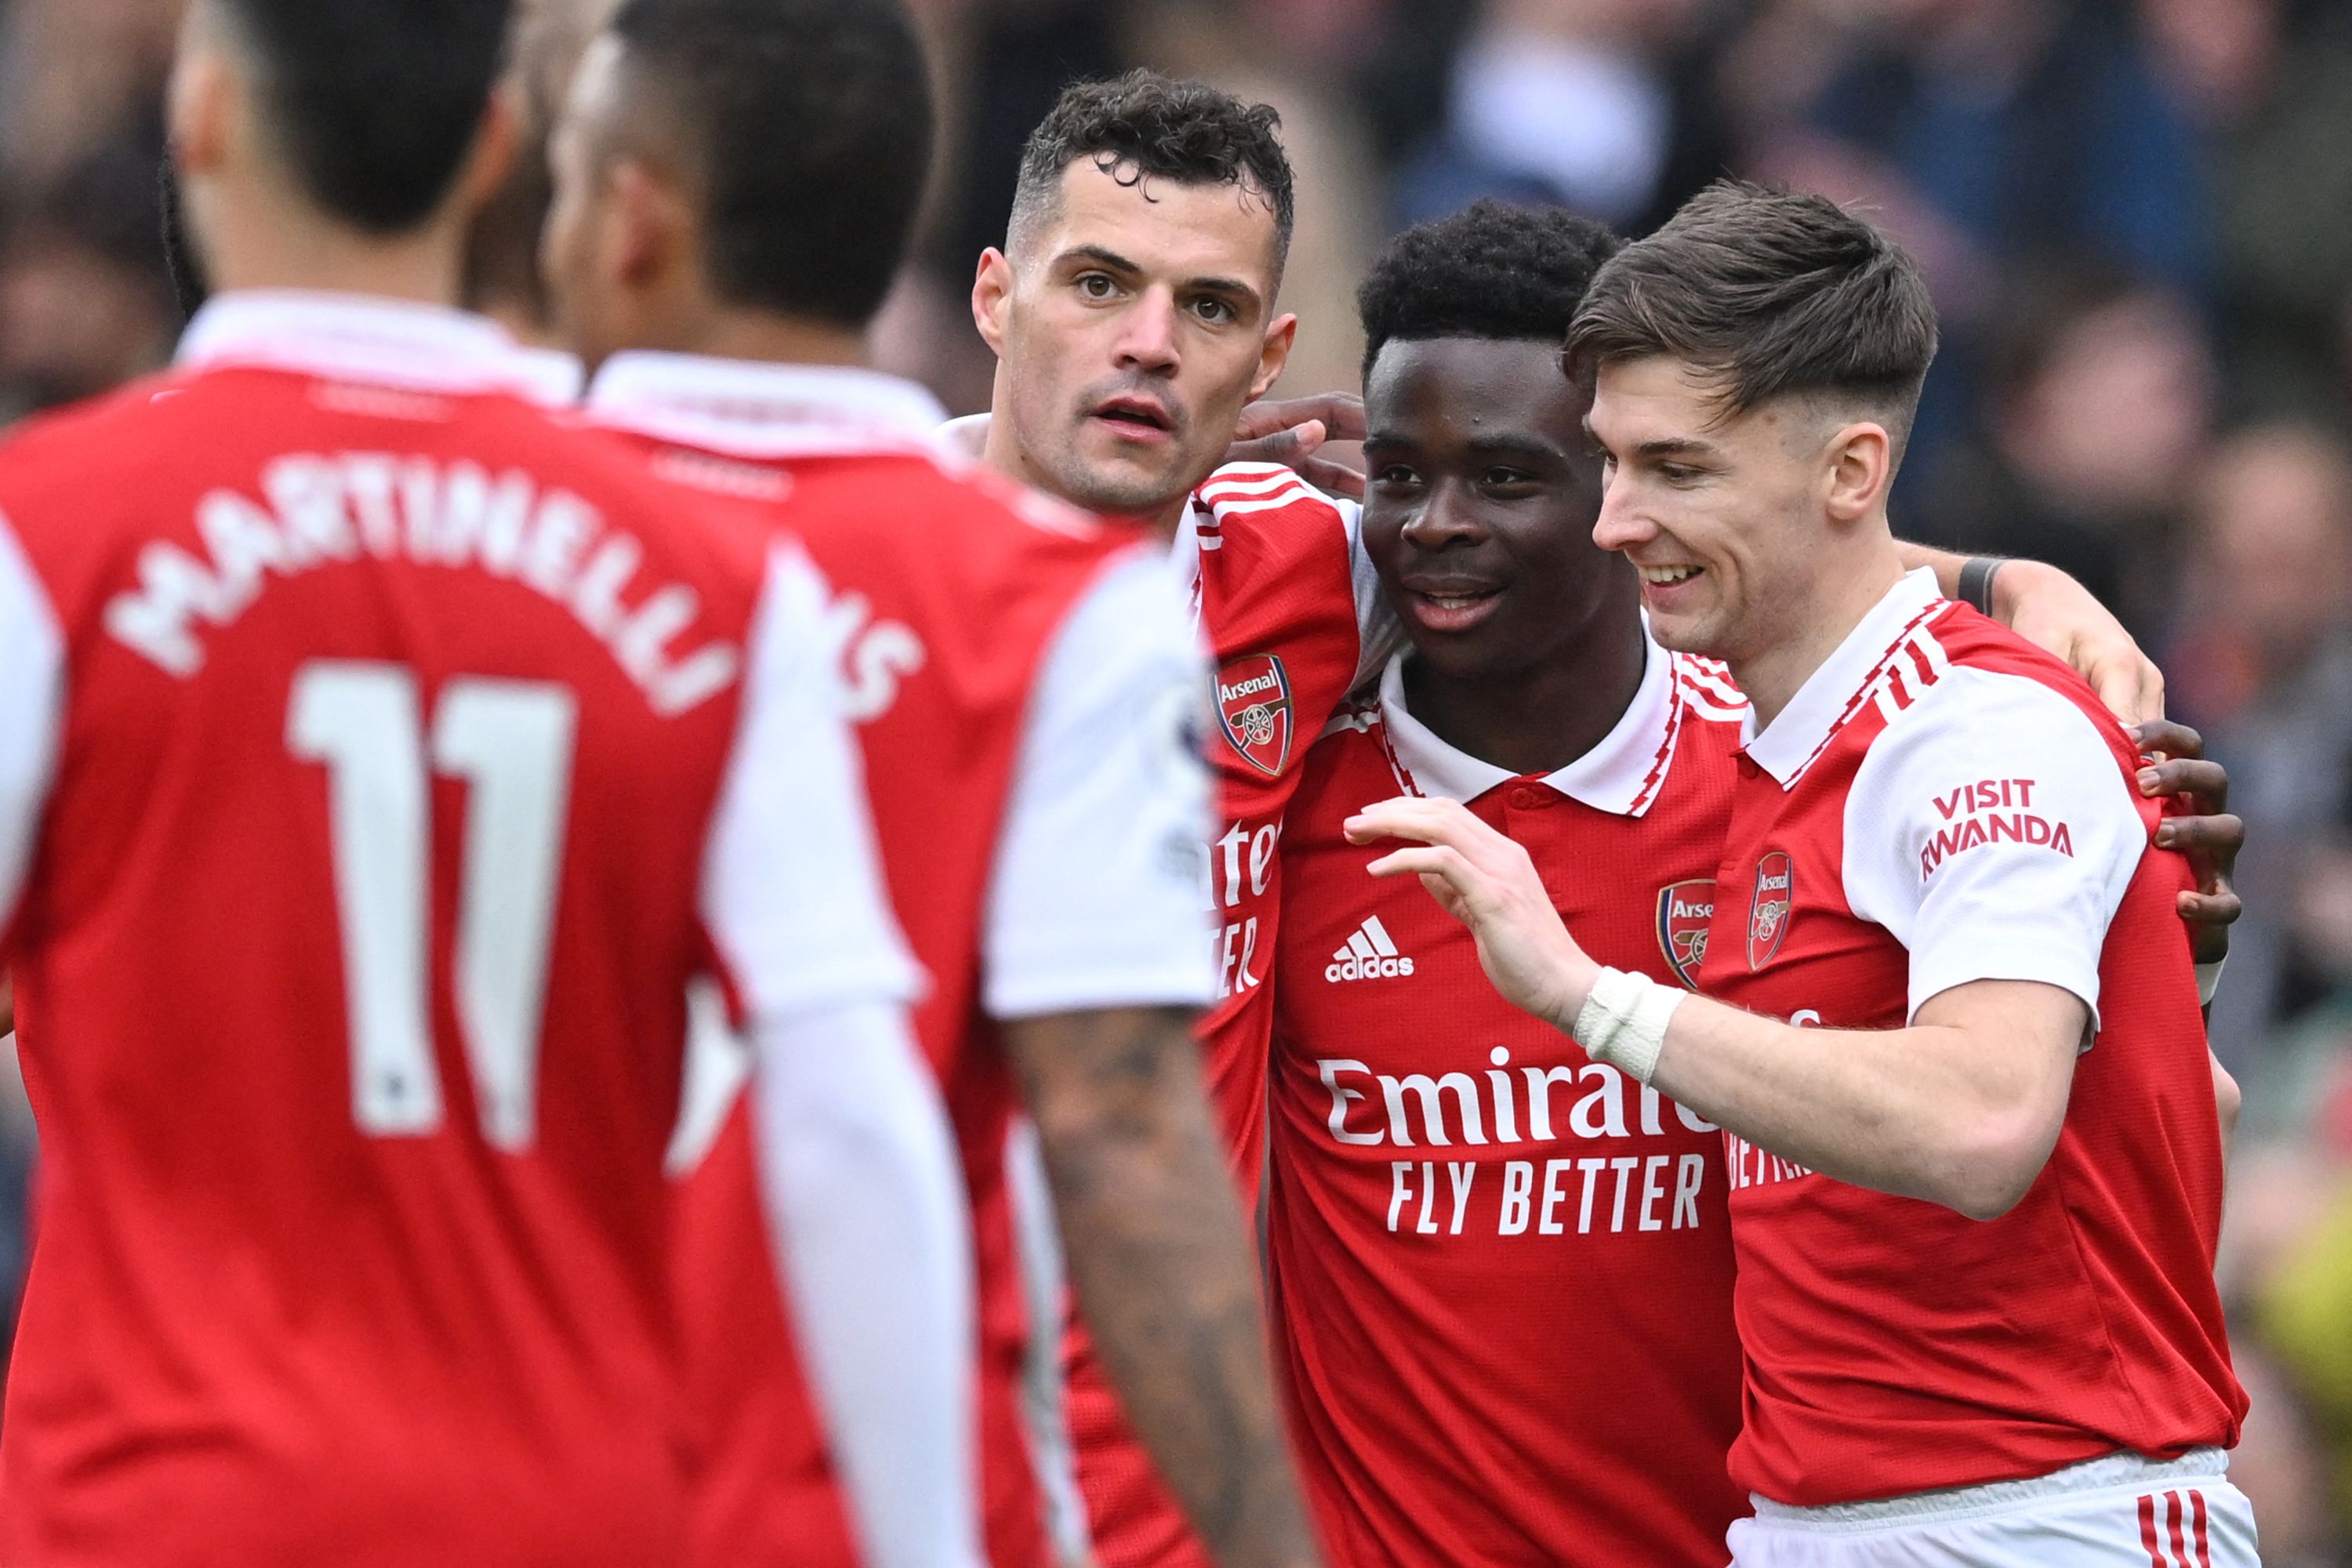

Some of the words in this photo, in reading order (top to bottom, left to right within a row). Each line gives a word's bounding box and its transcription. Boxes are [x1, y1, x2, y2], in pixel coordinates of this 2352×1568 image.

[103, 452, 741, 717] MARTINELLI
[1220, 670, 1277, 703] Arsenal
[1932, 779, 2036, 820] VISIT
[1920, 813, 2074, 884] RWANDA
[284, 657, 579, 1154] 11
[1760, 870, 1788, 891] Arsenal
[1671, 900, 1714, 919] Arse
[1325, 955, 1414, 983] adidas
[1316, 1046, 1722, 1147] Emira
[1387, 1160, 1476, 1235] FLY
[1498, 1153, 1704, 1236] BETTER
